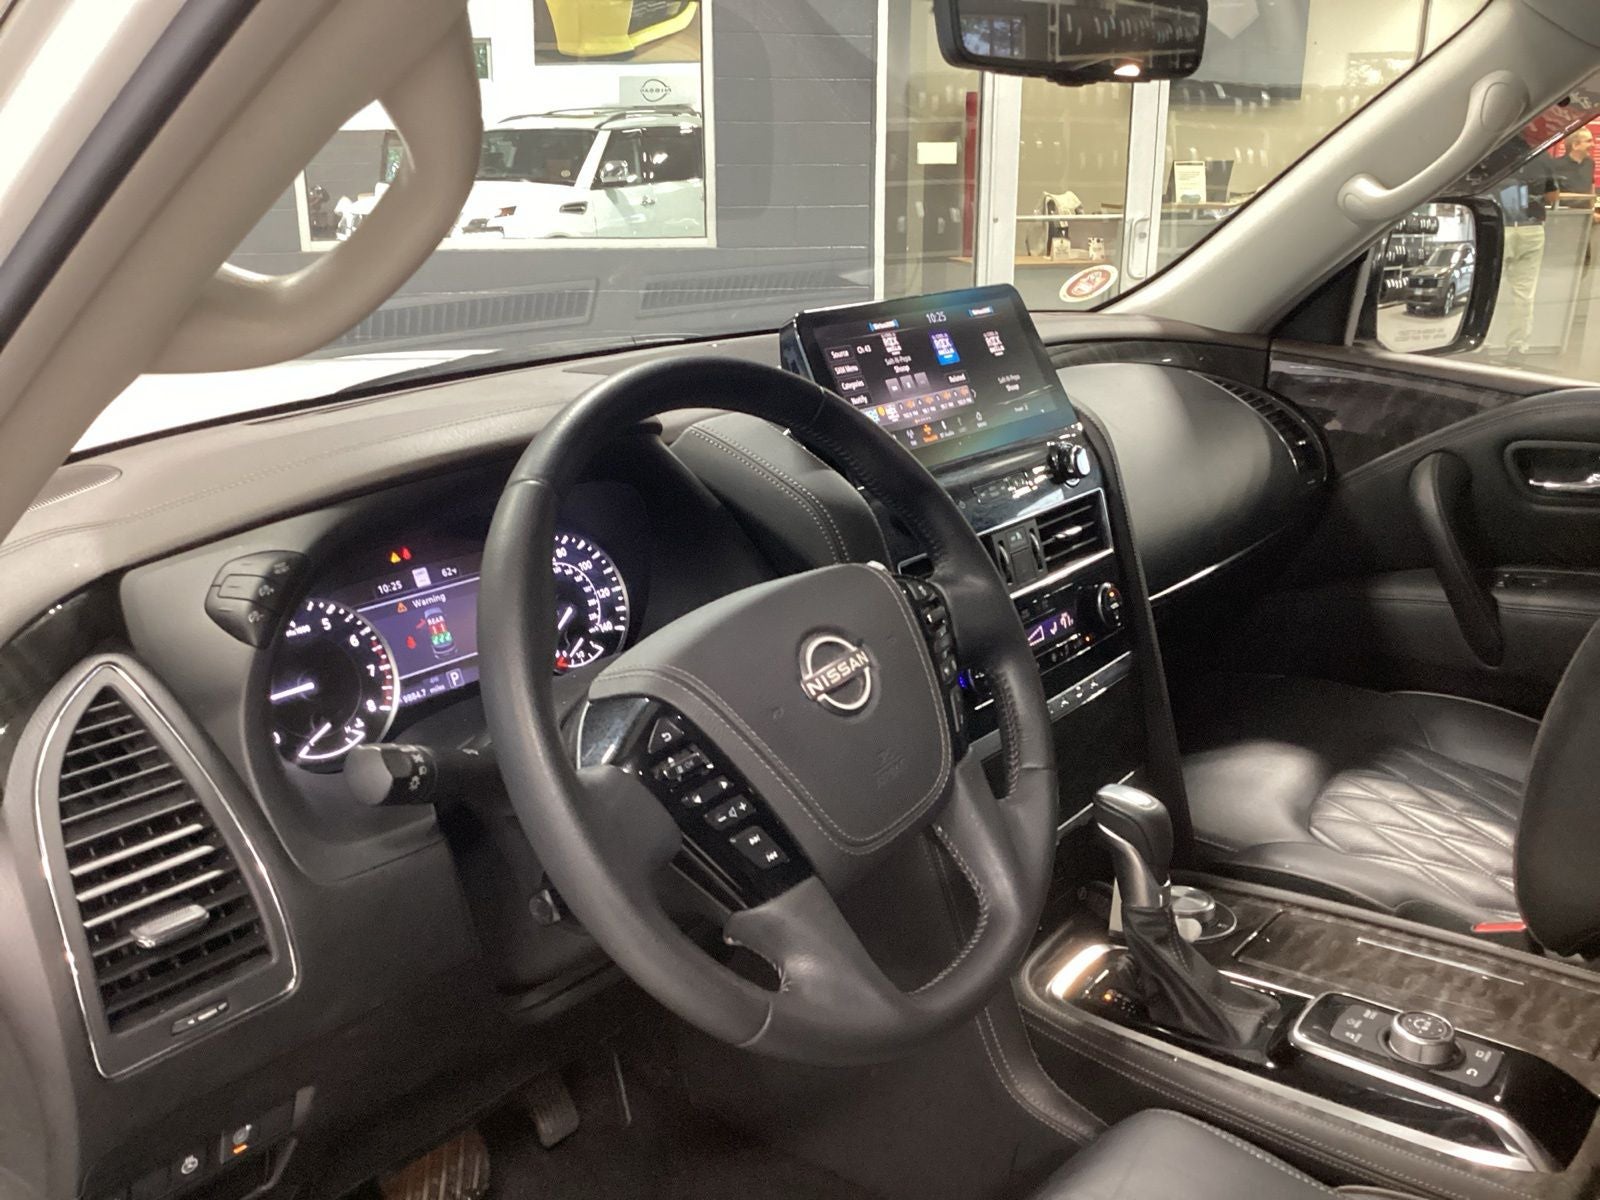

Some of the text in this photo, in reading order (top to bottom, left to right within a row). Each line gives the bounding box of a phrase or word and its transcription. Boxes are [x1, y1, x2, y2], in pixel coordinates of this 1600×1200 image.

[926, 311, 947, 324] 10:25
[831, 350, 850, 359] Source
[841, 380, 865, 391] Categories
[555, 547, 567, 559] 80
[578, 559, 593, 571] 100
[377, 580, 403, 594] 10:25
[597, 587, 611, 599] 120
[412, 593, 447, 608] Warning
[321, 617, 332, 631] 5
[599, 620, 613, 633] 140
[349, 634, 360, 648] 6
[365, 664, 376, 677] 7
[806, 648, 870, 697] NISSAN
[450, 671, 459, 686] P
[366, 699, 377, 712] 8
